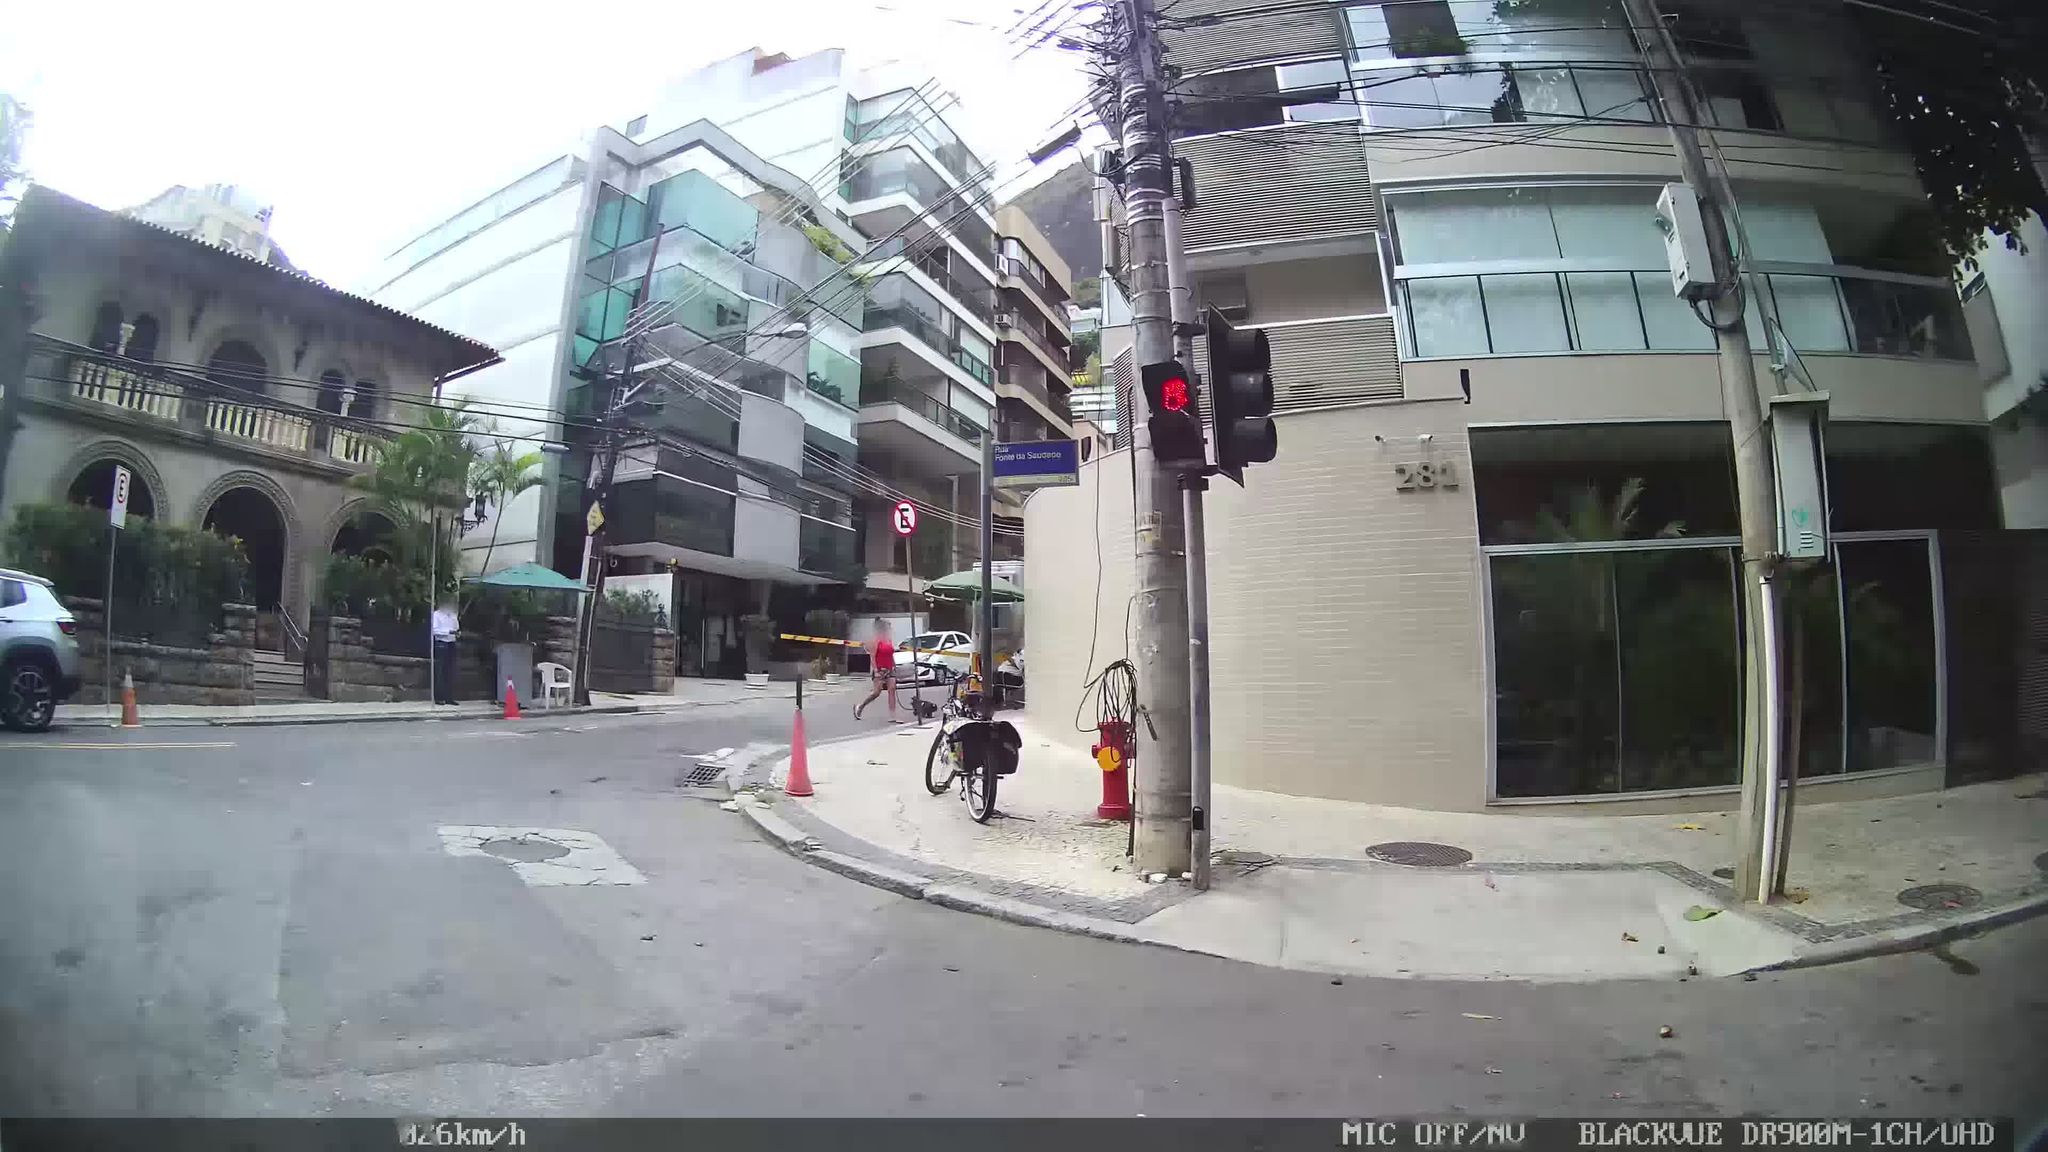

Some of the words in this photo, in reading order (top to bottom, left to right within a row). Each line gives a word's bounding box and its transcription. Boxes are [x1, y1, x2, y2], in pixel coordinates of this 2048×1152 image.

[995, 453, 1015, 461] Fonte
[1395, 462, 1459, 491] 281
[900, 508, 911, 528] E
